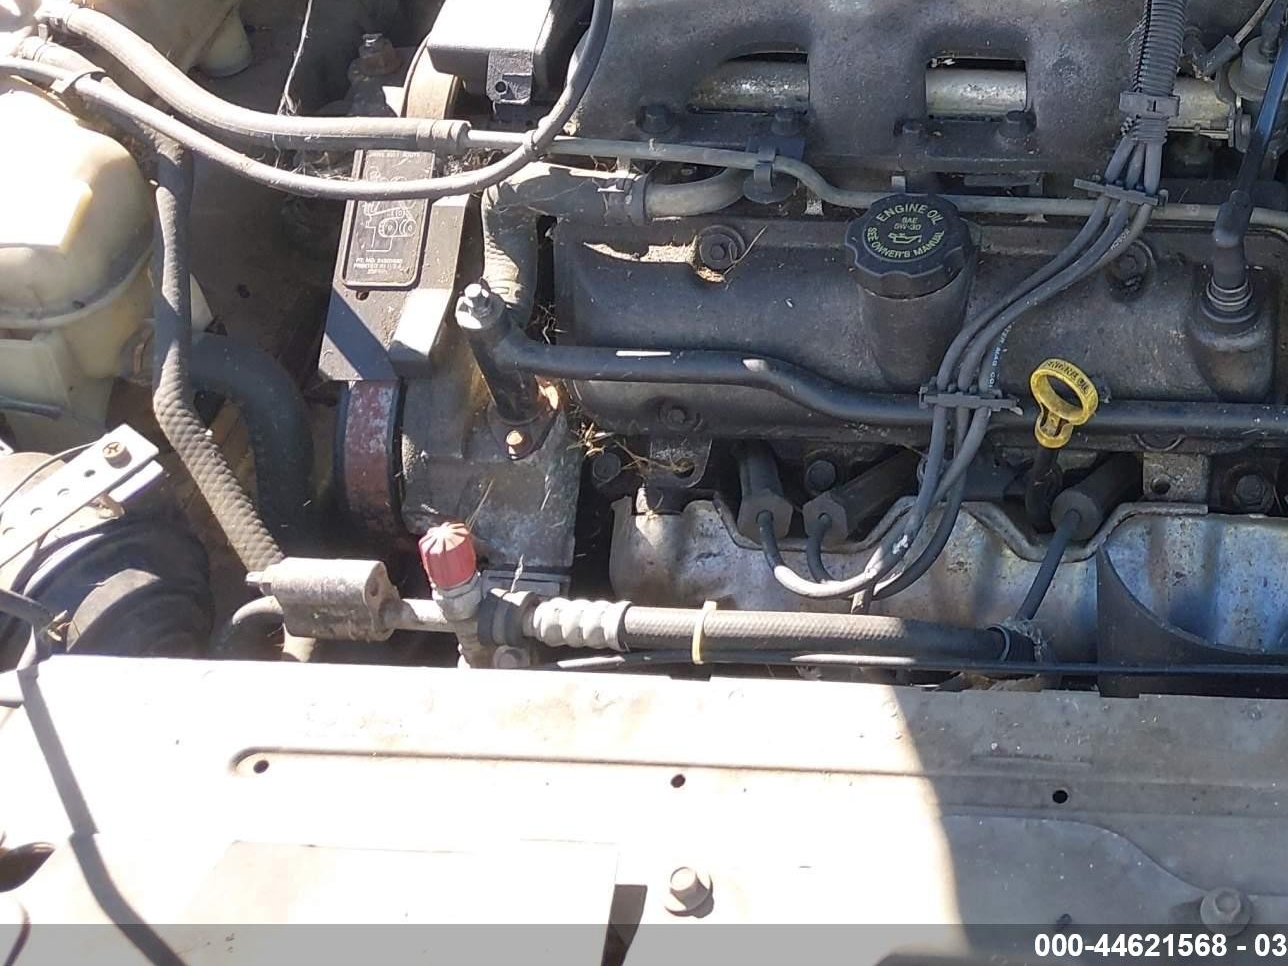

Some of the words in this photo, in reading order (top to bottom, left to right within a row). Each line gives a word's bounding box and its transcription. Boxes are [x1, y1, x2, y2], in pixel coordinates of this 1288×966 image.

[876, 203, 928, 222] ENGINE
[926, 210, 944, 225] OIL
[902, 216, 918, 224] SAE
[867, 227, 879, 242] SEE
[912, 230, 945, 256] MANUAL
[871, 241, 911, 258] OWNER'S
